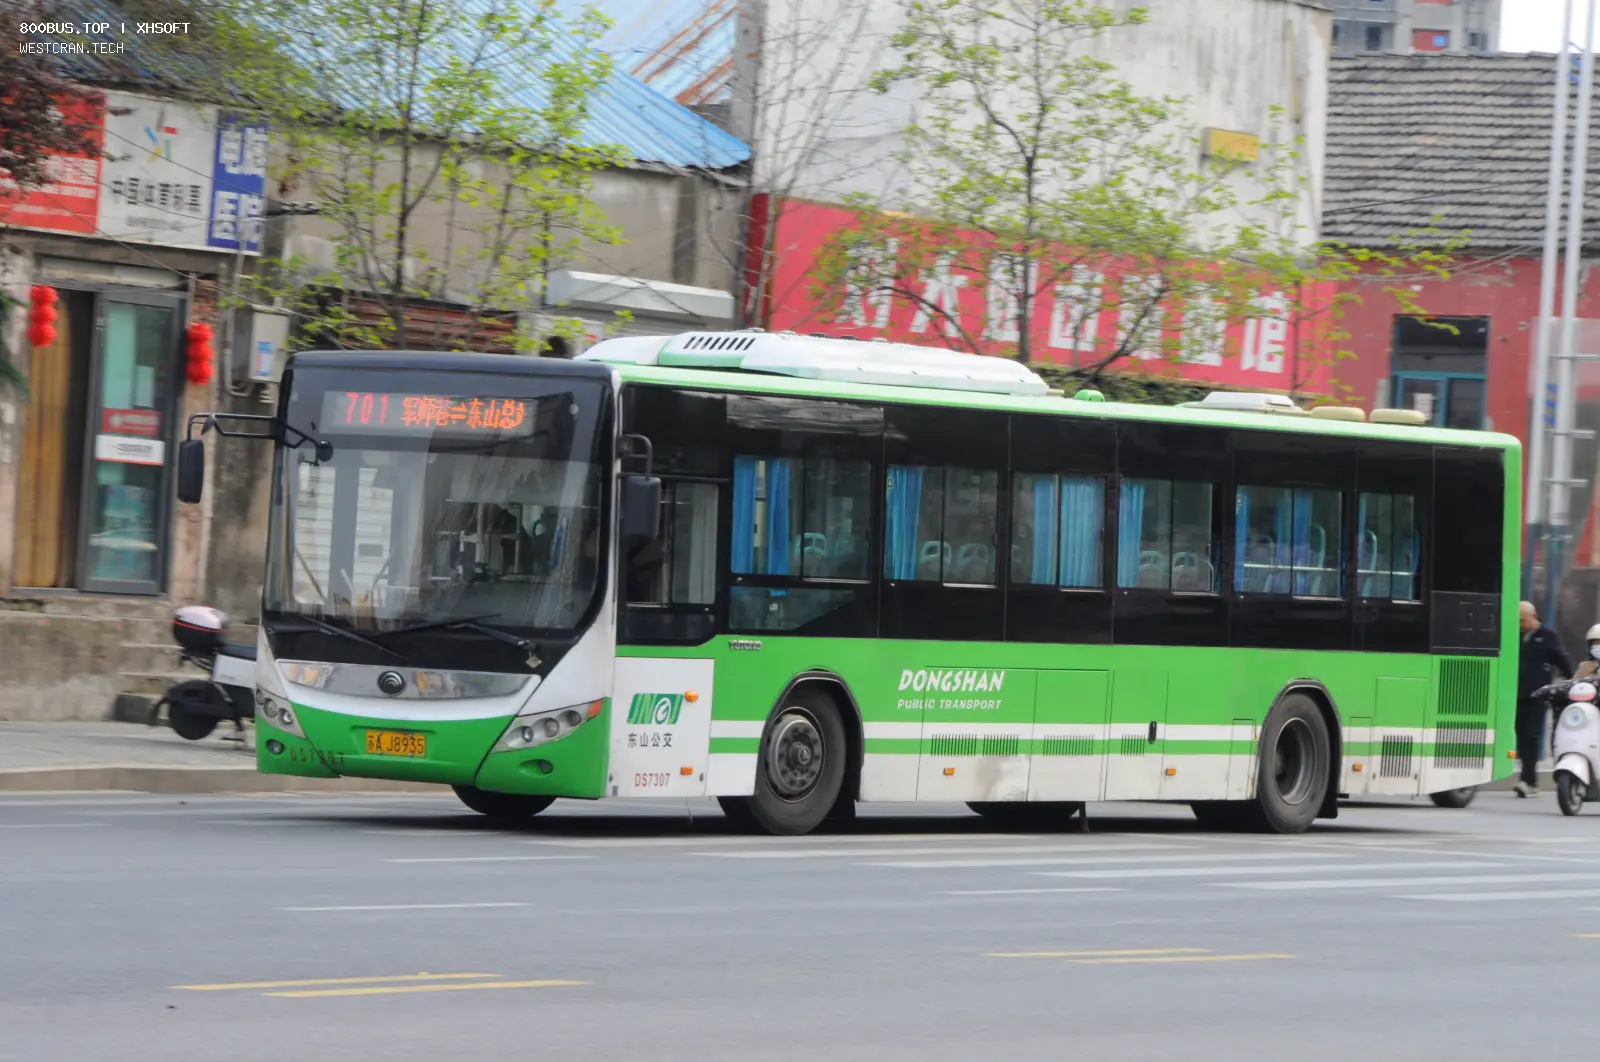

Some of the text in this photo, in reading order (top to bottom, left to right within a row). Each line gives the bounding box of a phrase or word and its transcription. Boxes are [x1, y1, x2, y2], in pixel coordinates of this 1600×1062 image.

[345, 391, 389, 425] 701
[898, 669, 1006, 692] DONGSHAN
[897, 699, 1002, 710] PUBLIC TRANSPORT
[627, 732, 673, 748] 东山公交
[634, 773, 671, 787] DS7307
